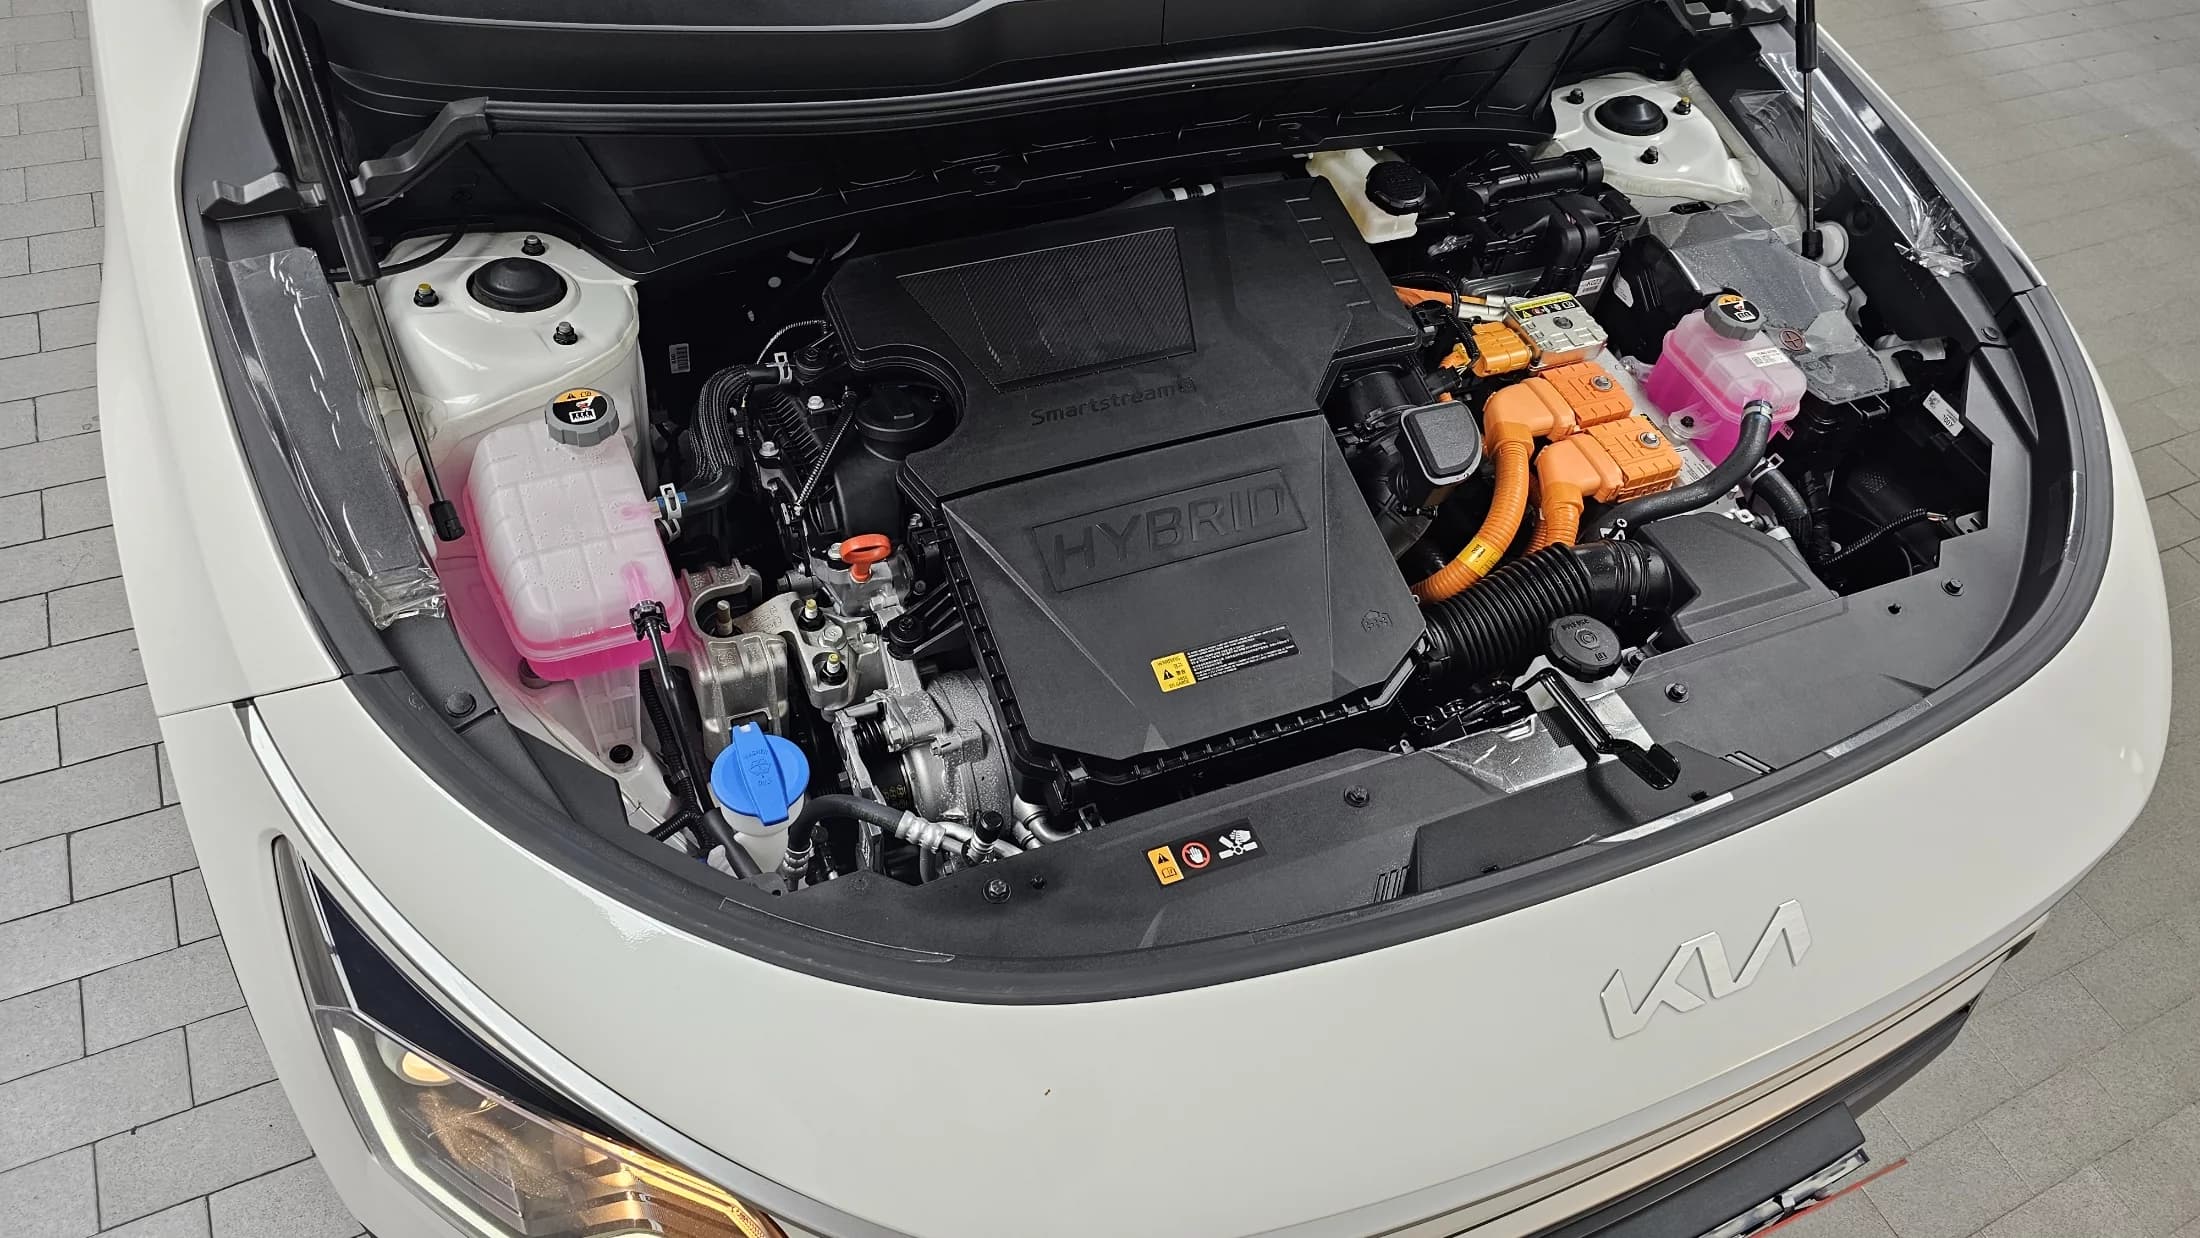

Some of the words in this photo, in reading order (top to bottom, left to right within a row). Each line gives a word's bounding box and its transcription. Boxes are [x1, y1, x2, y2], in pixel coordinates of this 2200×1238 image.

[1030, 384, 1176, 426] Smartstream
[1053, 481, 1285, 576] HYBRID
[1600, 899, 1812, 1040] KIA
